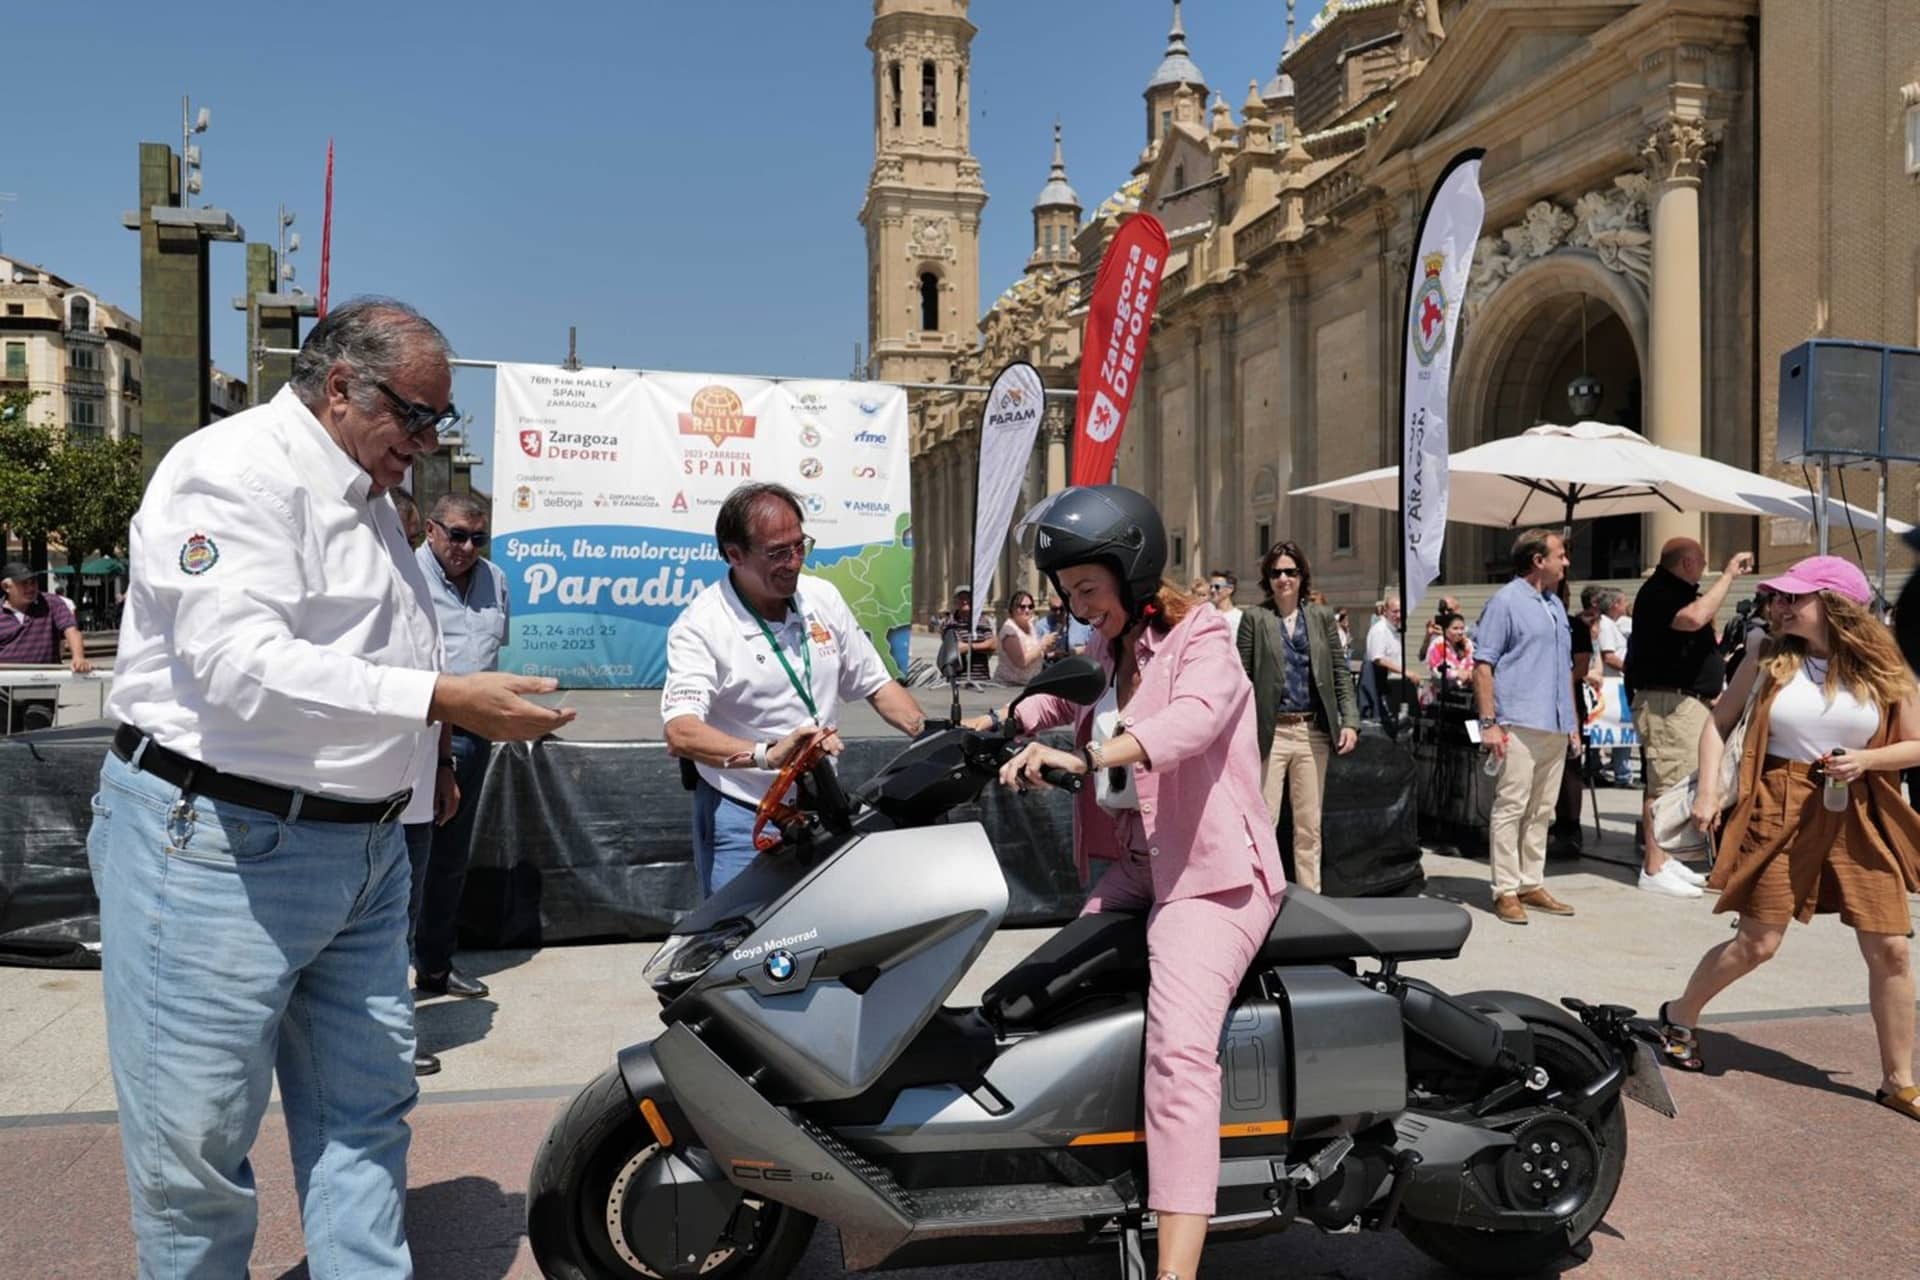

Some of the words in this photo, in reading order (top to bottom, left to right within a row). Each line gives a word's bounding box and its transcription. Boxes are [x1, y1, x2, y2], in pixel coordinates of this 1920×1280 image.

[1101, 244, 1142, 385] Zaragoza
[1113, 254, 1158, 399] DEPORTE
[552, 388, 586, 398] SPAIN
[547, 399, 597, 409] ZARAGOZA
[692, 416, 745, 433] RALLY
[989, 408, 1036, 426] FARAM
[549, 430, 618, 448] Zaragoza
[854, 430, 887, 444] rfme
[548, 446, 618, 462] DEPORTE
[709, 449, 751, 460] ZARAGOZA
[684, 460, 751, 477] SPAIN
[852, 501, 890, 514] AMBAR
[506, 538, 567, 562] Spain,
[572, 538, 608, 558] the
[610, 540, 723, 565] motorcyclin
[523, 562, 707, 607] Paradis
[522, 625, 542, 638] 23,
[546, 625, 564, 637] 24
[567, 624, 595, 637] and
[600, 625, 616, 637] 25
[522, 639, 559, 651] June
[562, 639, 596, 650] 2023
[732, 945, 763, 961] Goya
[763, 927, 818, 952] Motorrad
[732, 1166, 793, 1182] CE
[811, 1172, 835, 1182] 04
